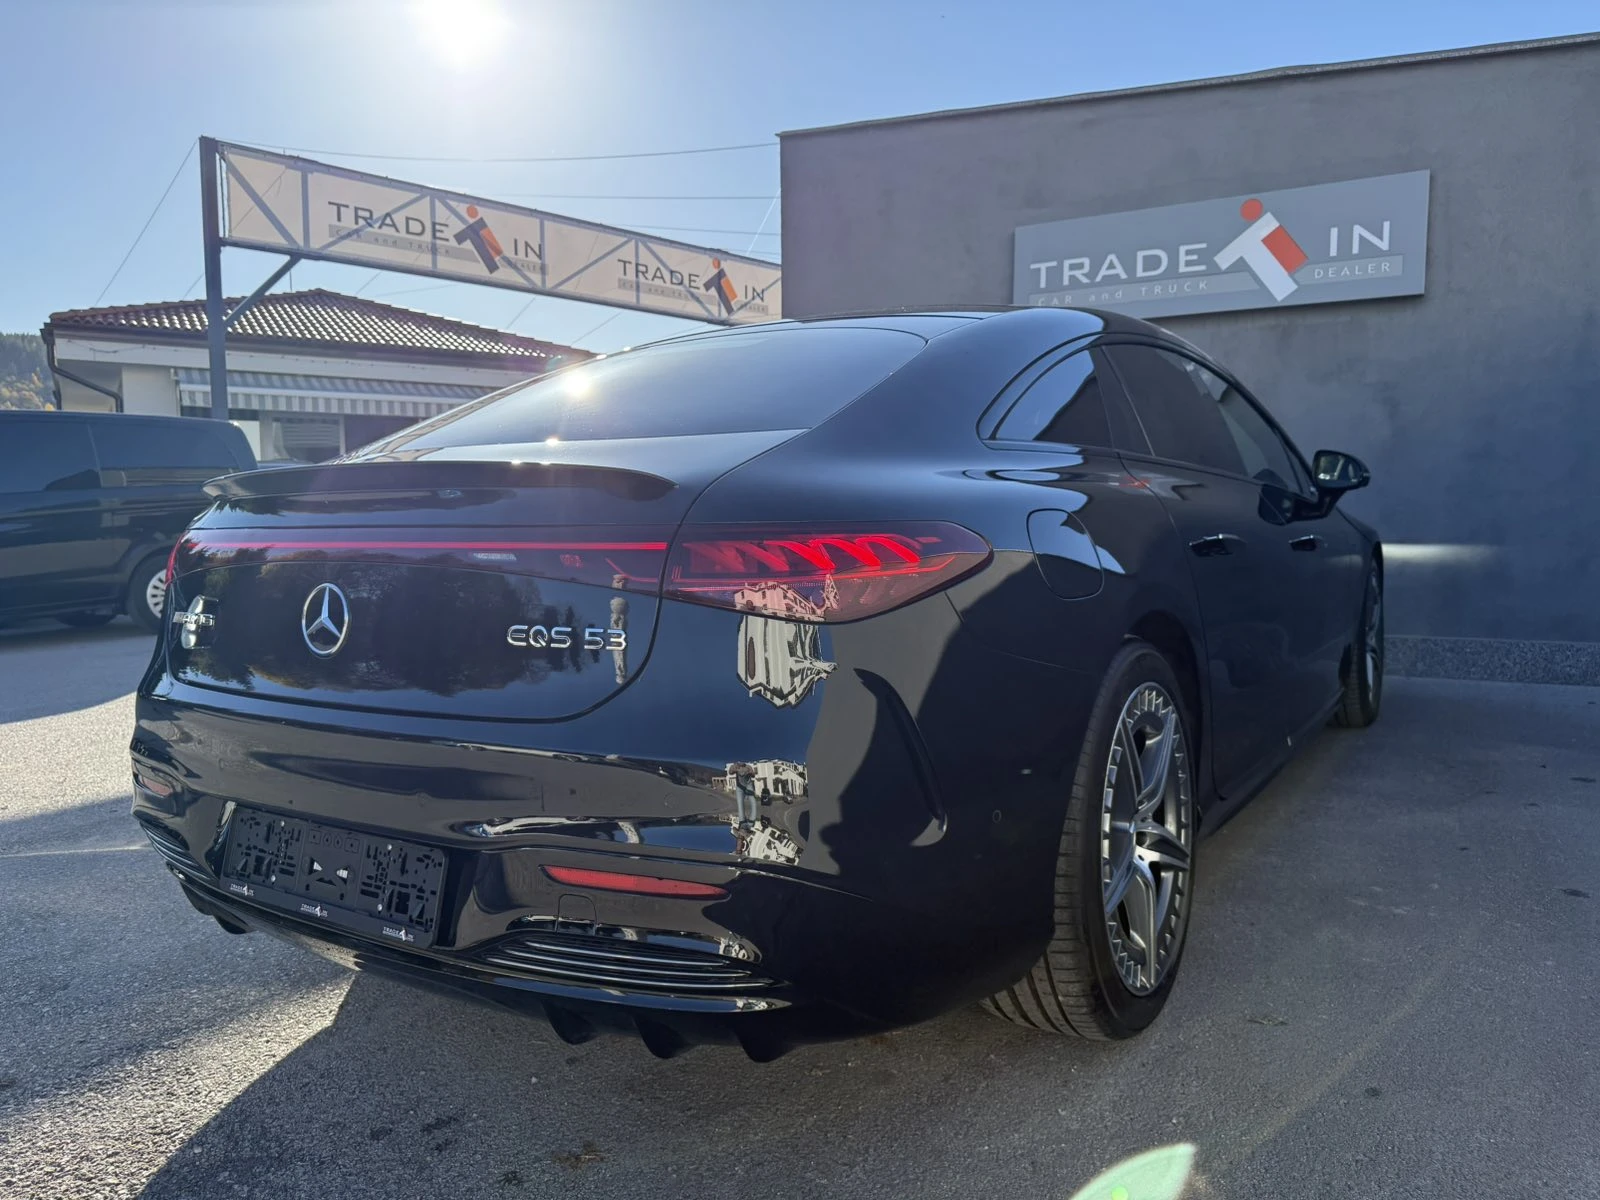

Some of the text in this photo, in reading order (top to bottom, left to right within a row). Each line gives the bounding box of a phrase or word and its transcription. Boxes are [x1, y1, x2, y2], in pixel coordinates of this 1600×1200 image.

[328, 201, 449, 242] TRADE
[514, 238, 542, 260] IN
[1030, 220, 1390, 289] TRADE IN
[1314, 262, 1390, 279] DEALER
[618, 259, 700, 290] TRADE
[745, 285, 765, 303] IN
[1089, 290, 1122, 303] and
[1140, 281, 1208, 297] TRUCK
[507, 625, 627, 650] EQS 53
